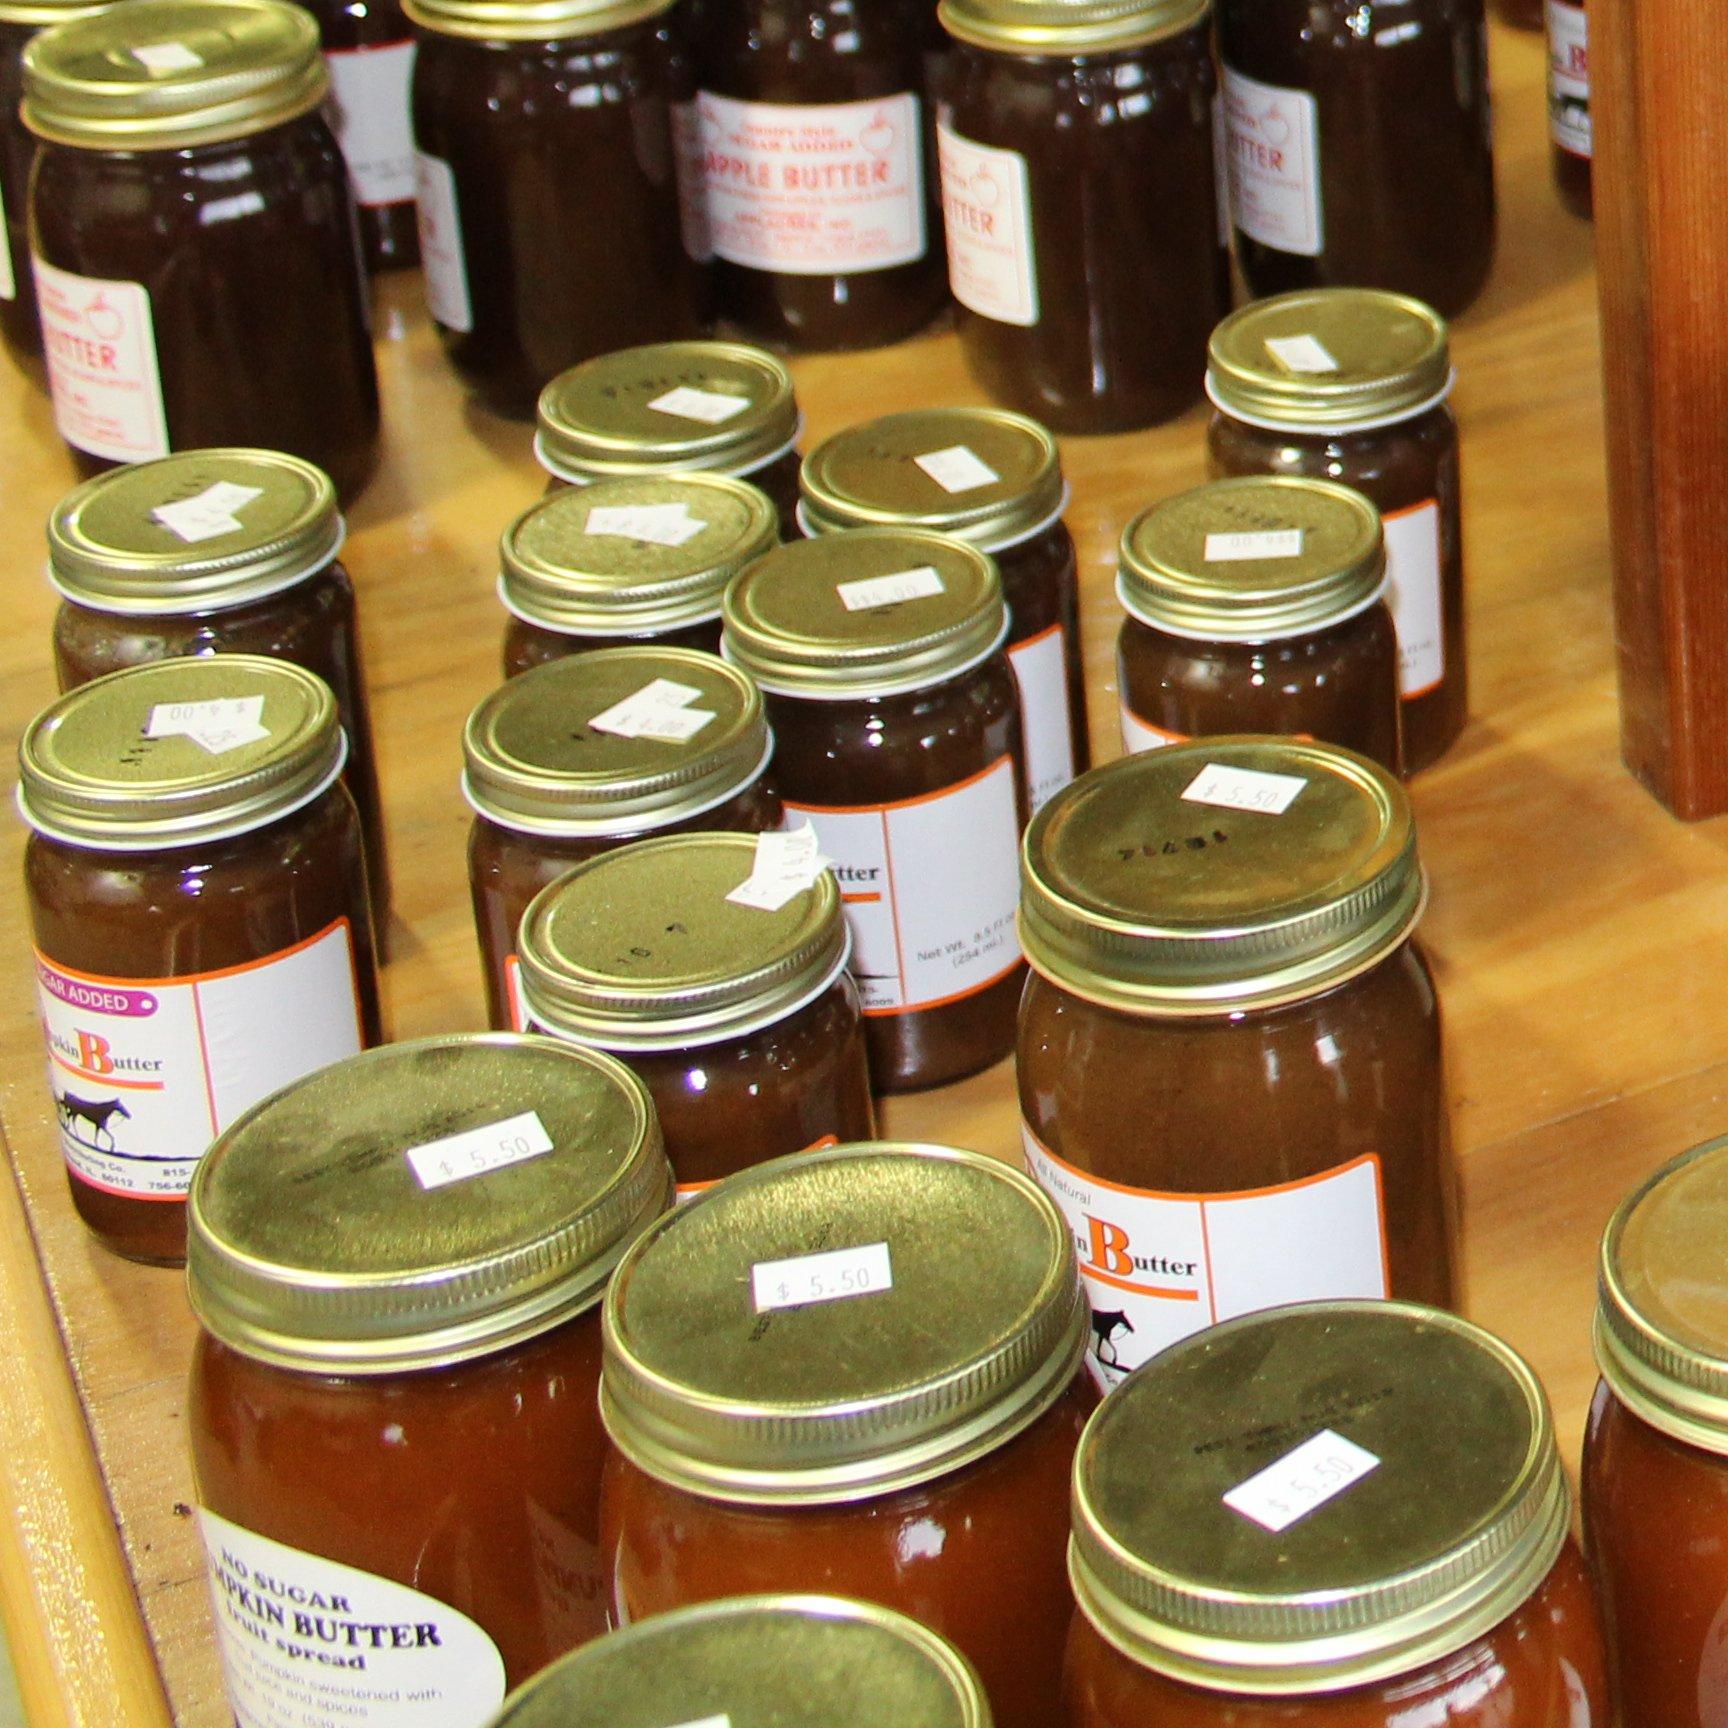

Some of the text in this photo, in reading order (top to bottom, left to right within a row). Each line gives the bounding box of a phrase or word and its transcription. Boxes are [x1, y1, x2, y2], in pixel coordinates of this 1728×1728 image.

[706, 150, 890, 190] APPLE BUTTER
[1224, 786, 1279, 808] 5.50
[829, 865, 879, 884] tter
[917, 948, 942, 963] Net
[68, 985, 129, 1012] ADDED
[73, 1026, 163, 1075] Butter
[469, 1135, 531, 1168] 5.50
[148, 1178, 190, 1191] 756-60
[1049, 1171, 1092, 1206] Natural
[1082, 1212, 1197, 1277] Butter
[775, 1266, 872, 1302] $ 5.50
[1290, 1456, 1354, 1500] 5.50
[221, 1544, 352, 1614] NO SUGAR
[292, 1609, 443, 1649] BUTTER
[275, 1637, 367, 1671] spread
[308, 1678, 400, 1703] sweetened
[406, 1687, 443, 1703] with
[316, 1697, 369, 1718] spices
